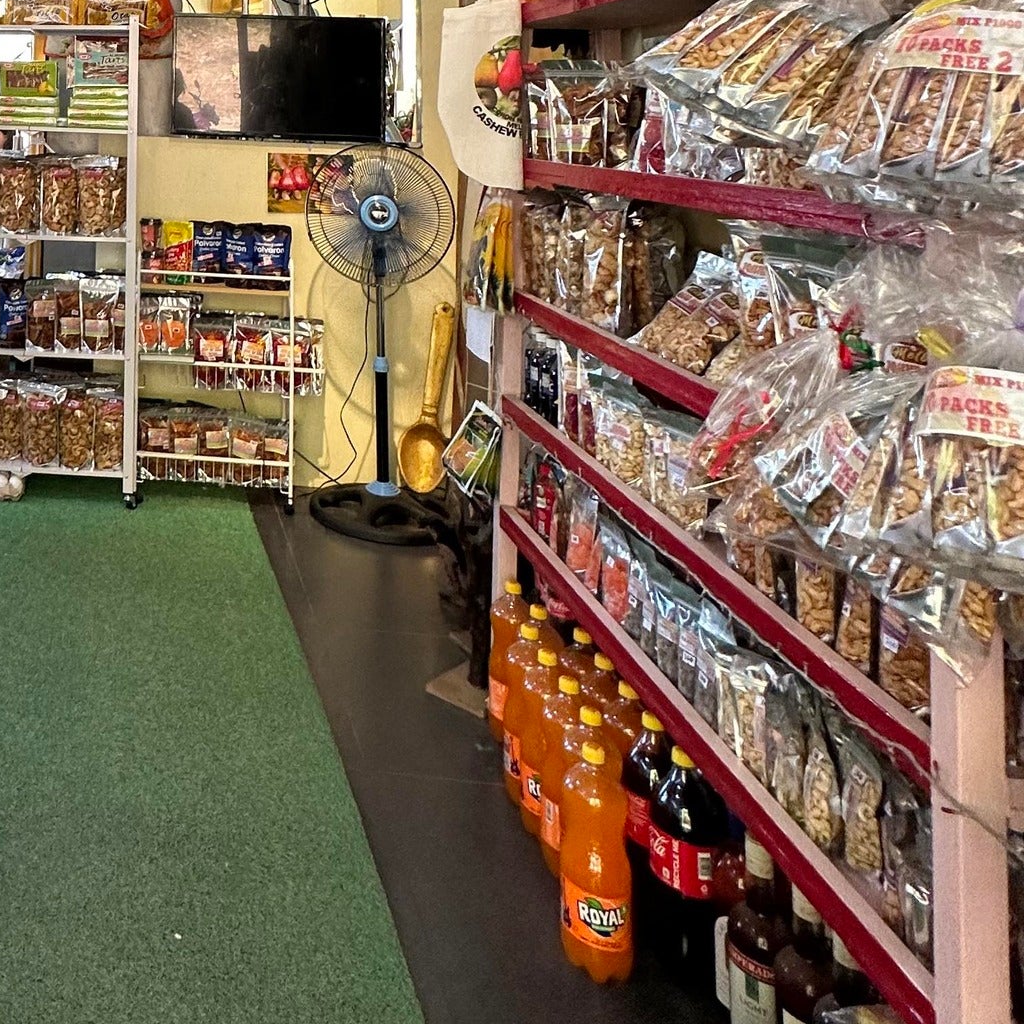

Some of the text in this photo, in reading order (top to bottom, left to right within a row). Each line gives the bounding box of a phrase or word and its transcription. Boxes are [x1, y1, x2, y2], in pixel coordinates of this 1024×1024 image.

[919, 37, 984, 56] PACKS
[940, 50, 1013, 73] FREE 2
[472, 105, 518, 138] CASHEW
[940, 396, 1010, 419] PACKS
[965, 415, 1021, 440] FREE
[577, 900, 625, 926] ROYAL
